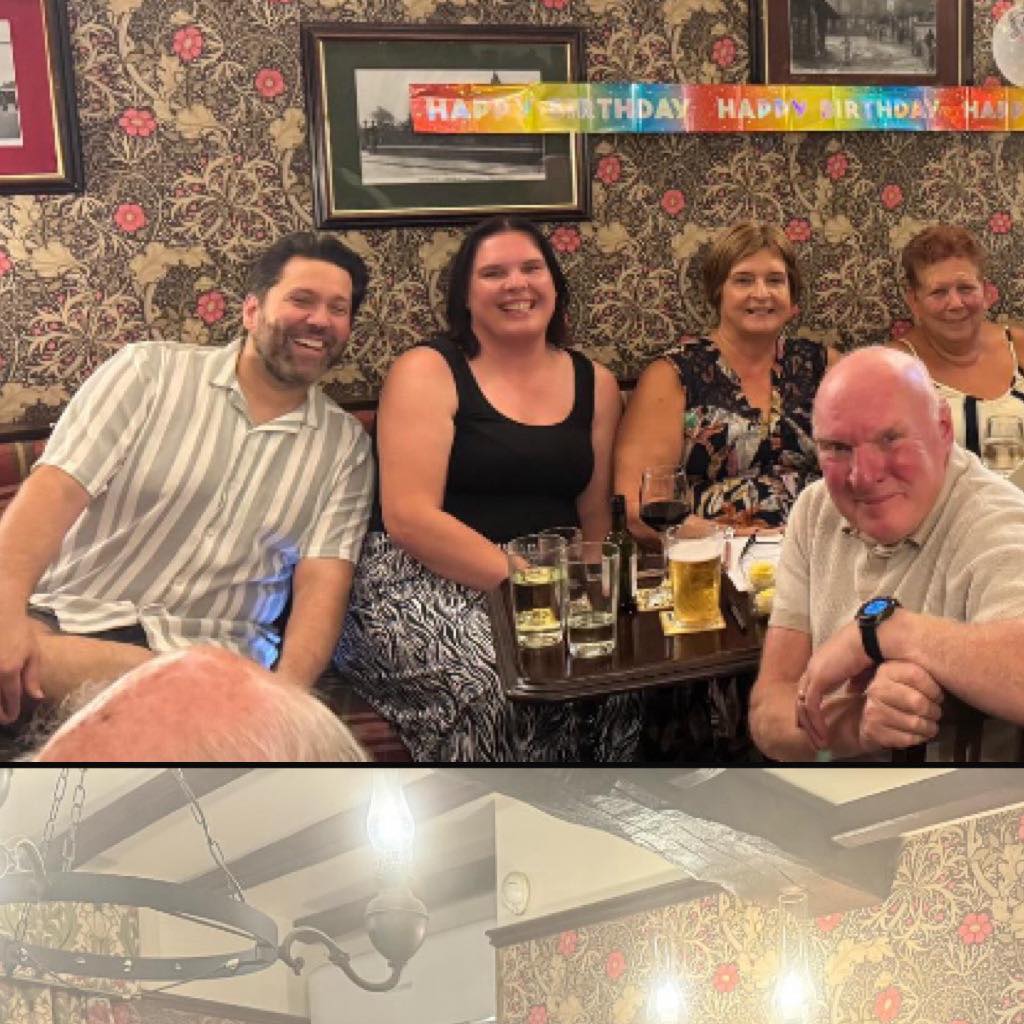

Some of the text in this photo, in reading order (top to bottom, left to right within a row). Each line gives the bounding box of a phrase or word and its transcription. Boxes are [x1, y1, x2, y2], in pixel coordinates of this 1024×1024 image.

[426, 97, 533, 121] HAPPY
[717, 98, 807, 119] HAPPY
[819, 98, 940, 119] BIRTHDAY
